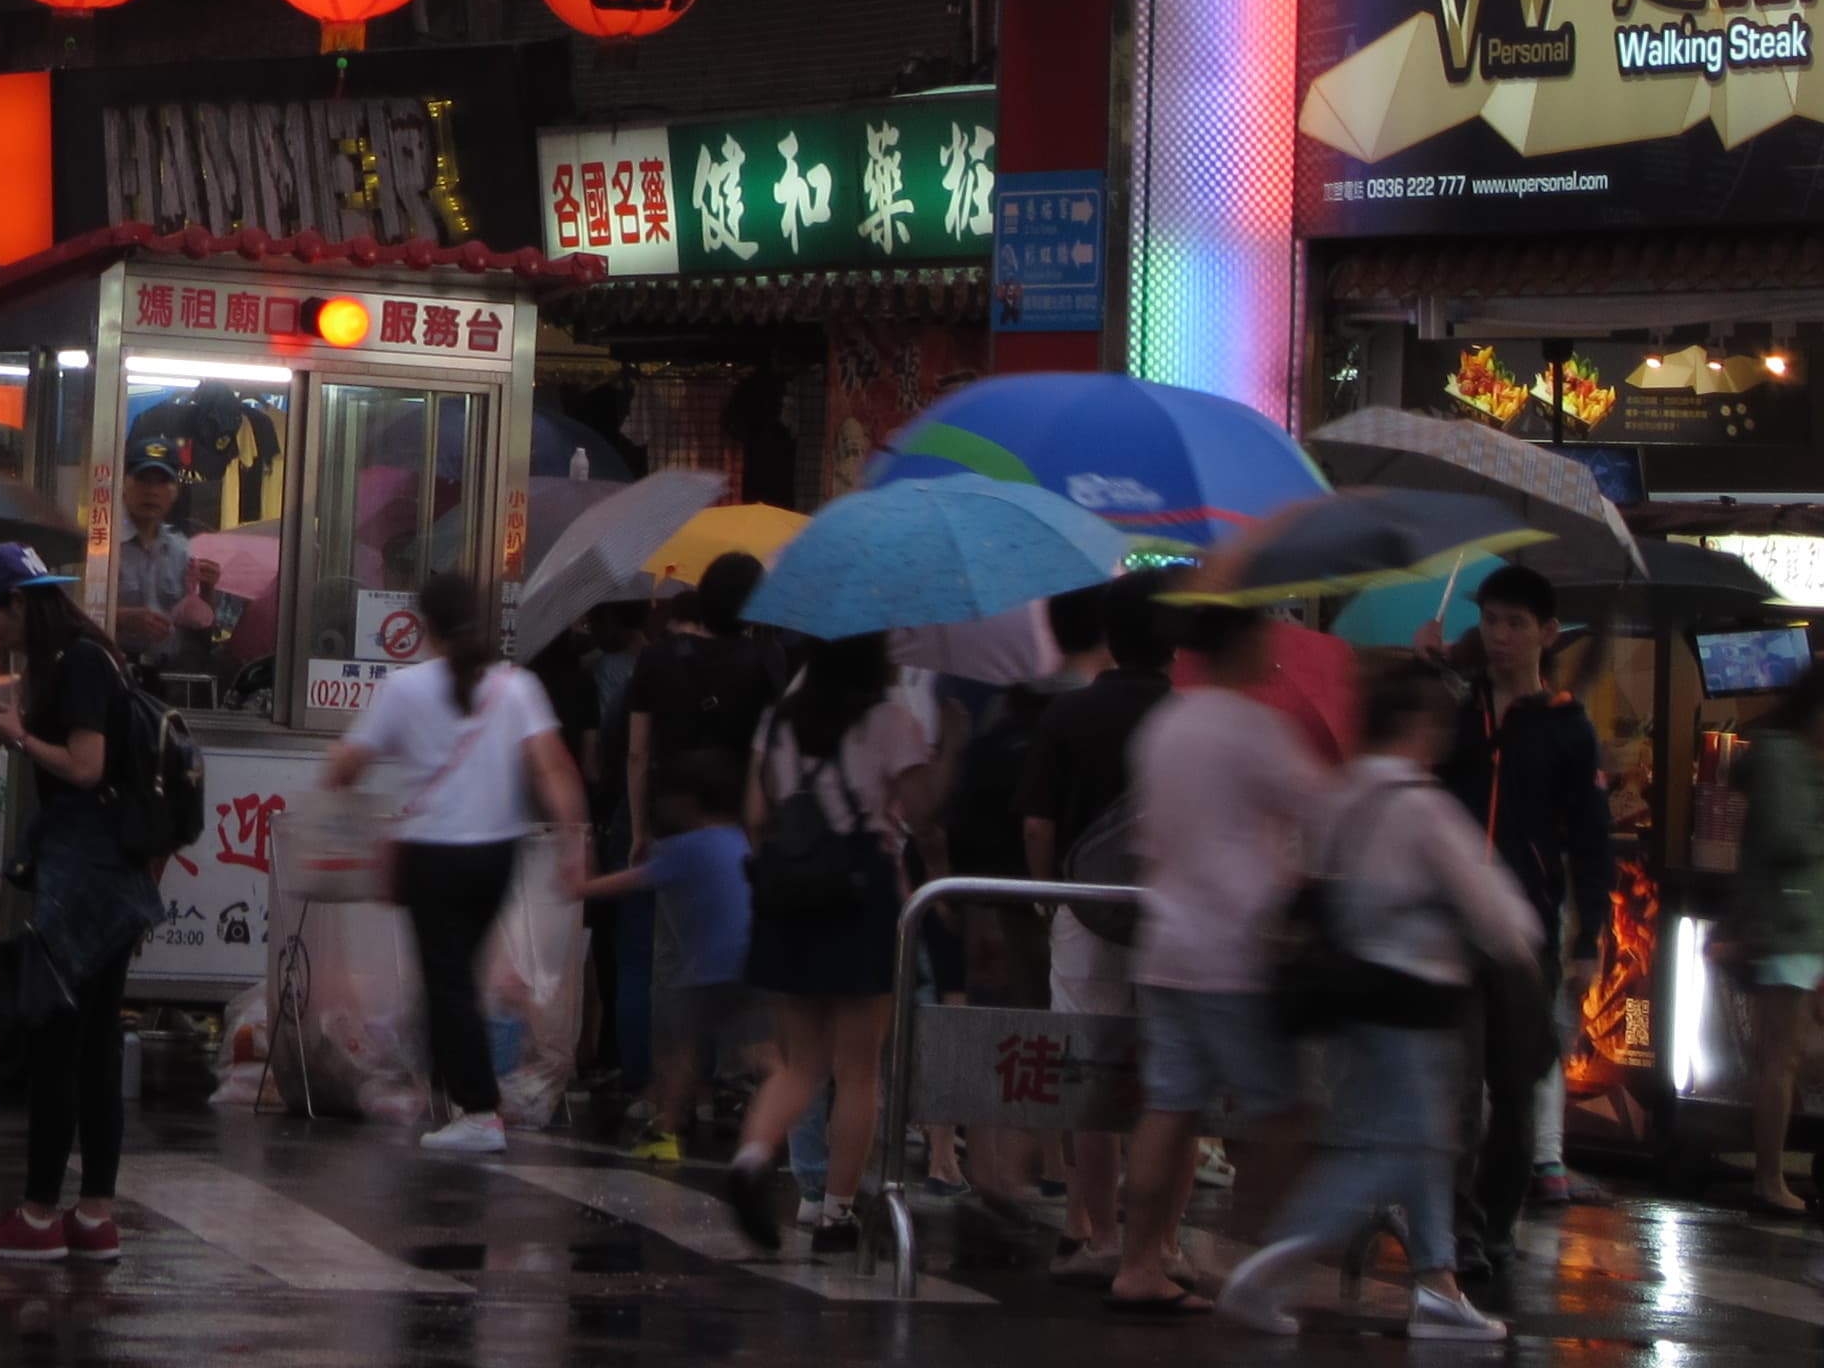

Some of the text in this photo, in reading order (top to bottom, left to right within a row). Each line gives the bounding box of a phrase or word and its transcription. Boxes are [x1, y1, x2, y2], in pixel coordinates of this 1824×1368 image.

[1488, 34, 1569, 67] Personal
[1618, 19, 1808, 72] Walking Steak
[552, 157, 671, 249] 各國名藥
[1367, 178, 1403, 199] 0936
[1406, 176, 1434, 198] 222
[1438, 175, 1466, 196] 777
[1472, 171, 1609, 198] www.wpersonal.com
[136, 282, 504, 353] 媽祖廟口 服務台
[90, 464, 111, 546] 小心扒手
[310, 679, 383, 709] (02)27
